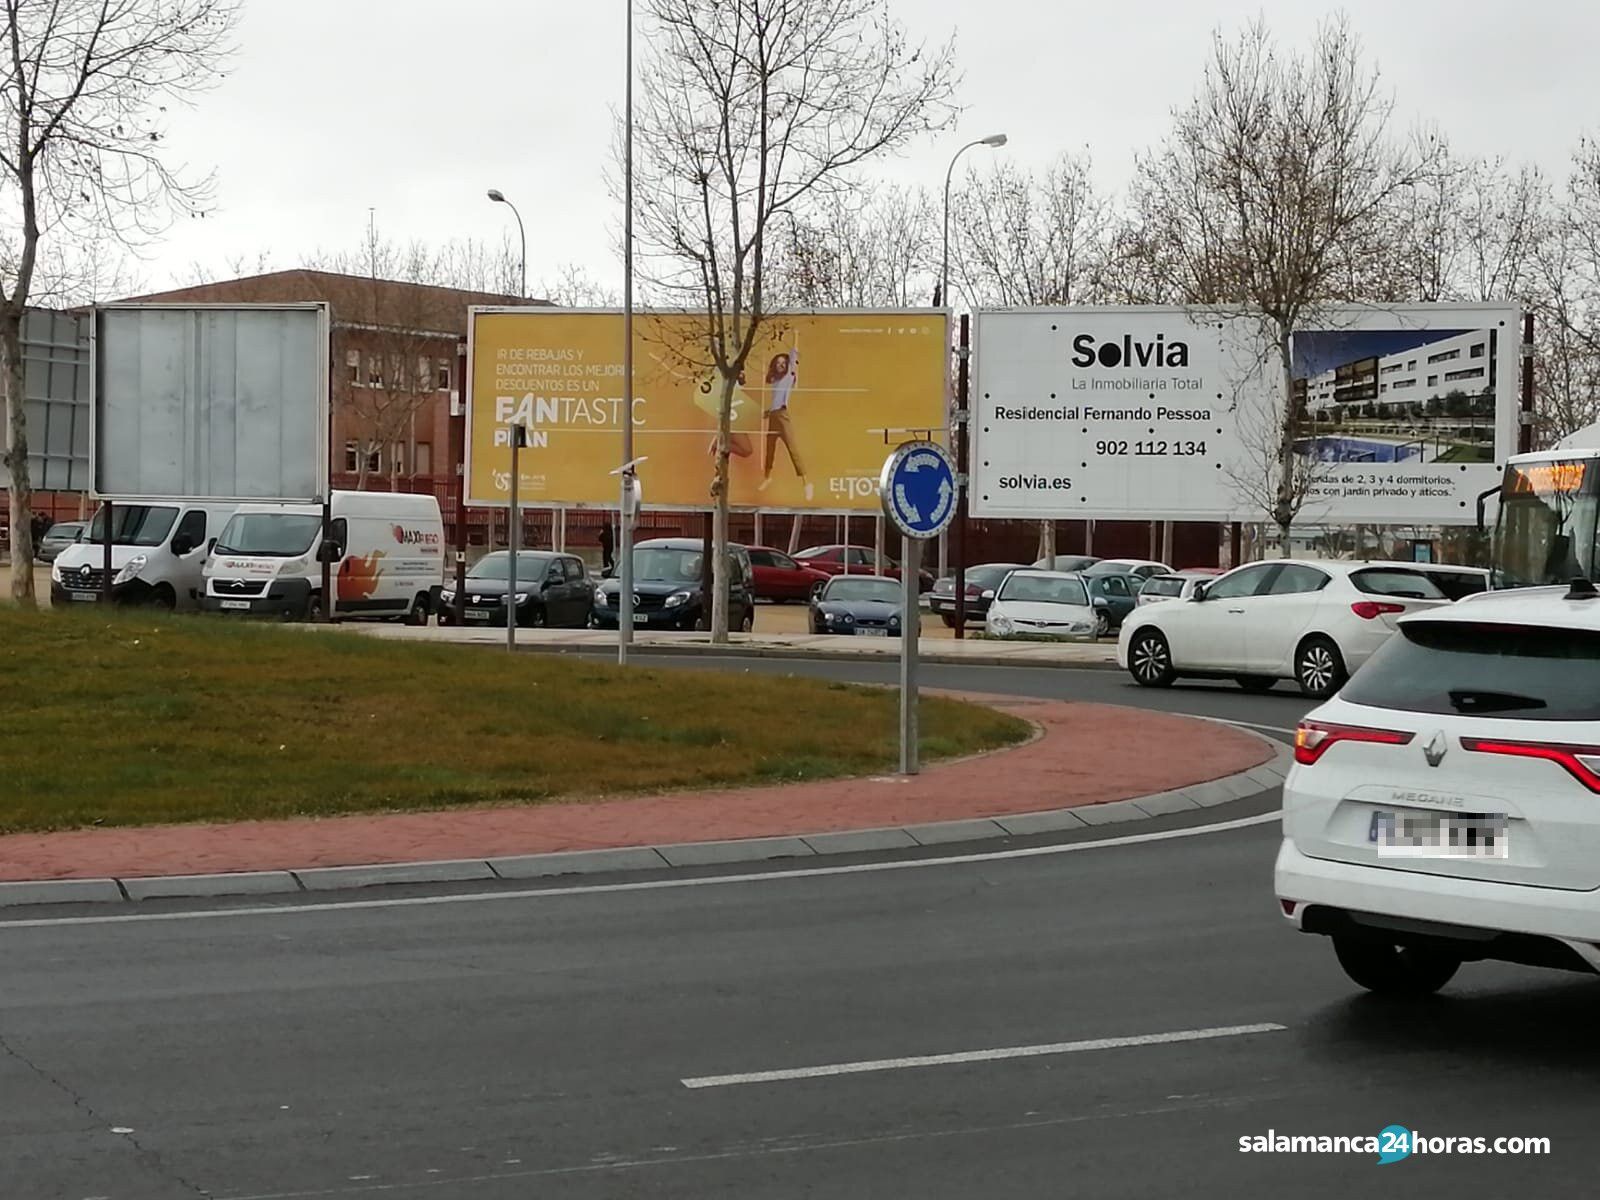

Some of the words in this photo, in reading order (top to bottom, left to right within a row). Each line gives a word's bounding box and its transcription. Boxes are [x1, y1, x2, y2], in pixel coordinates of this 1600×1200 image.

[497, 349, 507, 360] IR
[510, 349, 525, 360] DE
[527, 349, 574, 361] REBAJAS
[577, 350, 584, 360] Y
[1071, 333, 1189, 368] Solvia
[496, 364, 560, 376] ENCONTRAR
[563, 365, 584, 377] LOS
[586, 364, 635, 377] MEJOR
[495, 379, 564, 391] DESCUENTOS
[567, 380, 579, 391] ES
[582, 380, 600, 391] UN
[1072, 378, 1086, 390] La
[1091, 378, 1167, 390] Inmobiliaria
[1171, 378, 1203, 390] Total
[495, 392, 647, 429] FANTASTC
[995, 406, 1079, 420] Residencial
[1084, 406, 1152, 420] Fernando
[1157, 407, 1211, 421] Pessoa
[1096, 441, 1128, 456] 902
[1135, 441, 1167, 456] 112
[1173, 441, 1207, 456] 134
[999, 474, 1072, 489] solvia.es
[1341, 475, 1354, 484] de
[1369, 474, 1376, 484] 3
[1378, 477, 1384, 486] y
[1386, 475, 1393, 484] 4
[1323, 488, 1340, 496] con
[1372, 487, 1408, 498] privado
[1410, 489, 1416, 499] y
